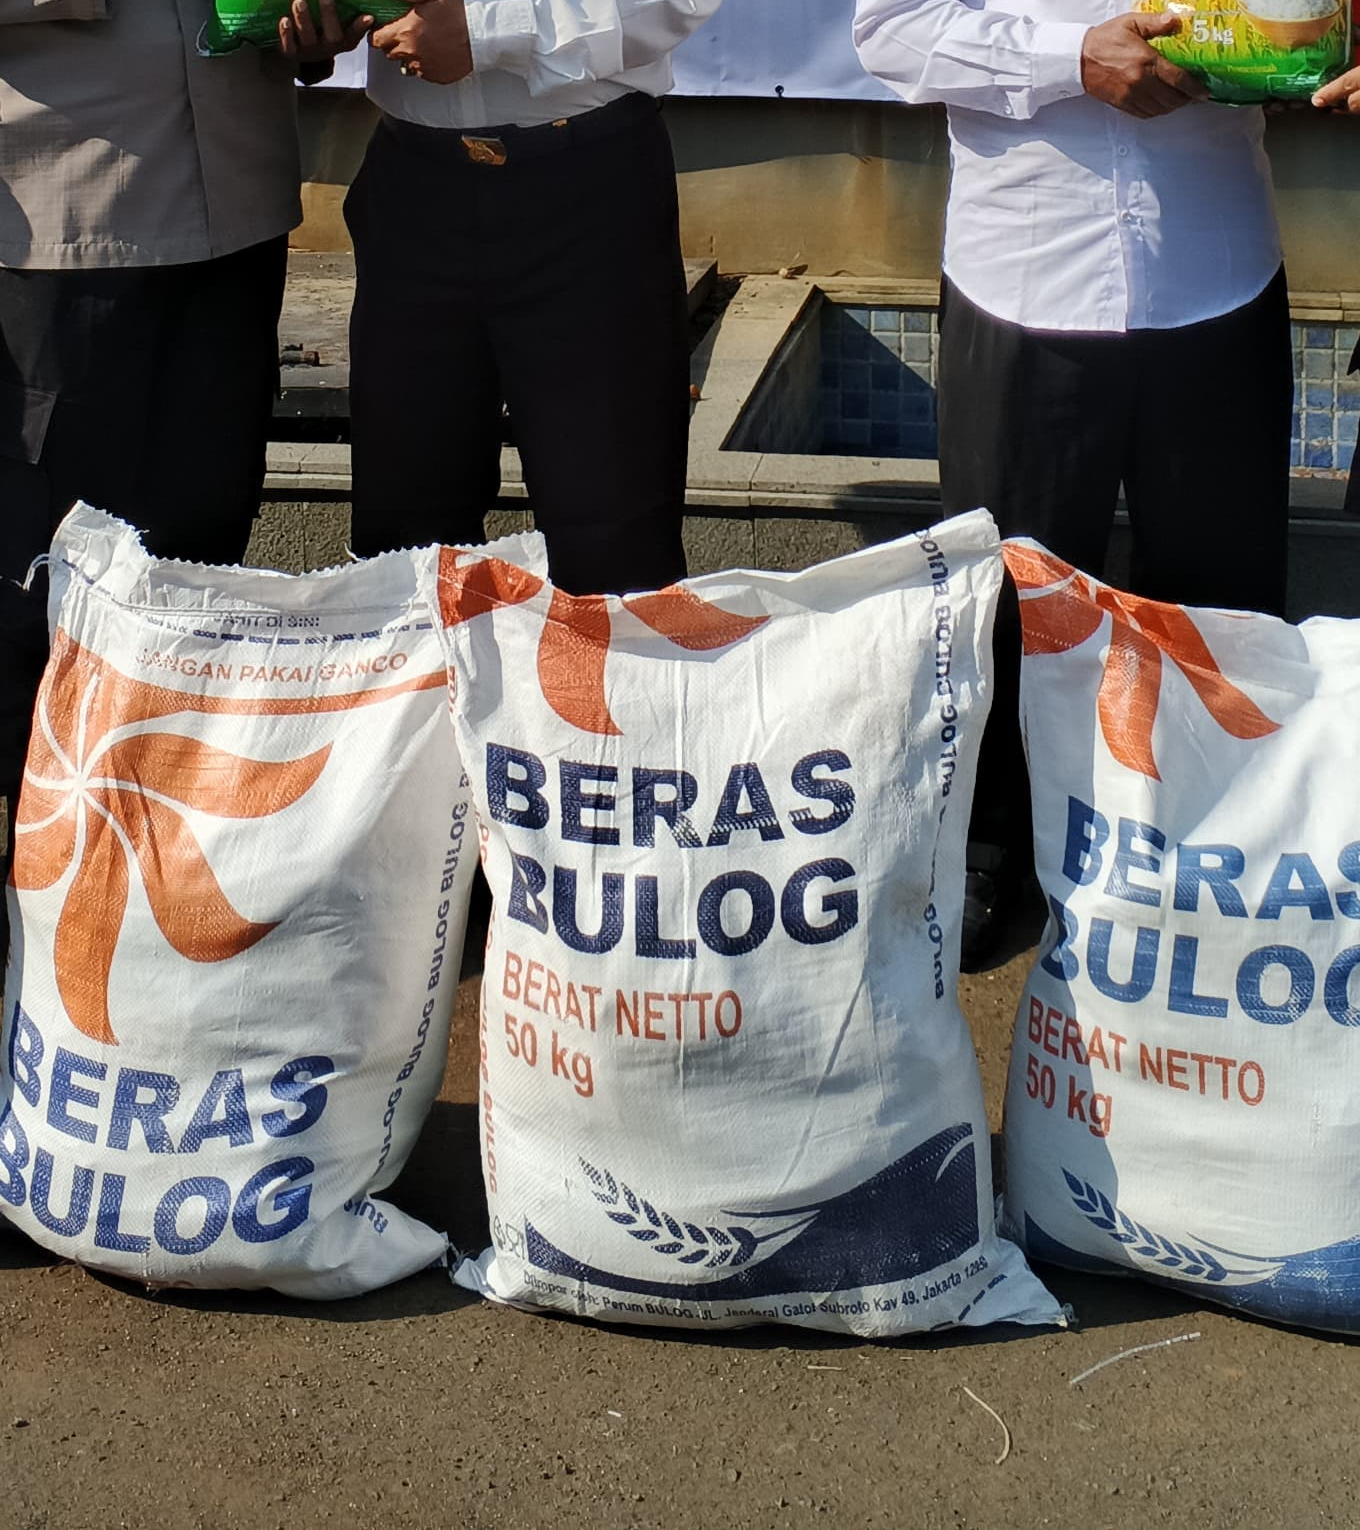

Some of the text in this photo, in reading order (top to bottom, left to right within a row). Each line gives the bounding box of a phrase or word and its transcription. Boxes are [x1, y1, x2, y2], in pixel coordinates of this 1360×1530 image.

[1193, 19, 1234, 45] 5 kg
[239, 665, 311, 683] PAKAI
[486, 742, 856, 849] BERAS
[939, 704, 959, 798] BULOG
[440, 801, 469, 894] BULOG
[427, 899, 450, 992] BULOG
[507, 850, 859, 960] BULOG
[924, 902, 944, 1000] BULOG
[396, 997, 435, 1084] BULOG
[502, 950, 745, 1042] BERAT NETTO
[9, 1001, 335, 1155] BERAS
[504, 1011, 595, 1099] 50 kg
[1025, 1053, 1113, 1138] 50 kg
[1028, 996, 1267, 1107] BERAT NETTO
[603, 1297, 643, 1313] Perum
[874, 1297, 897, 1312] Kav
[923, 1272, 962, 1301] Jakarta
